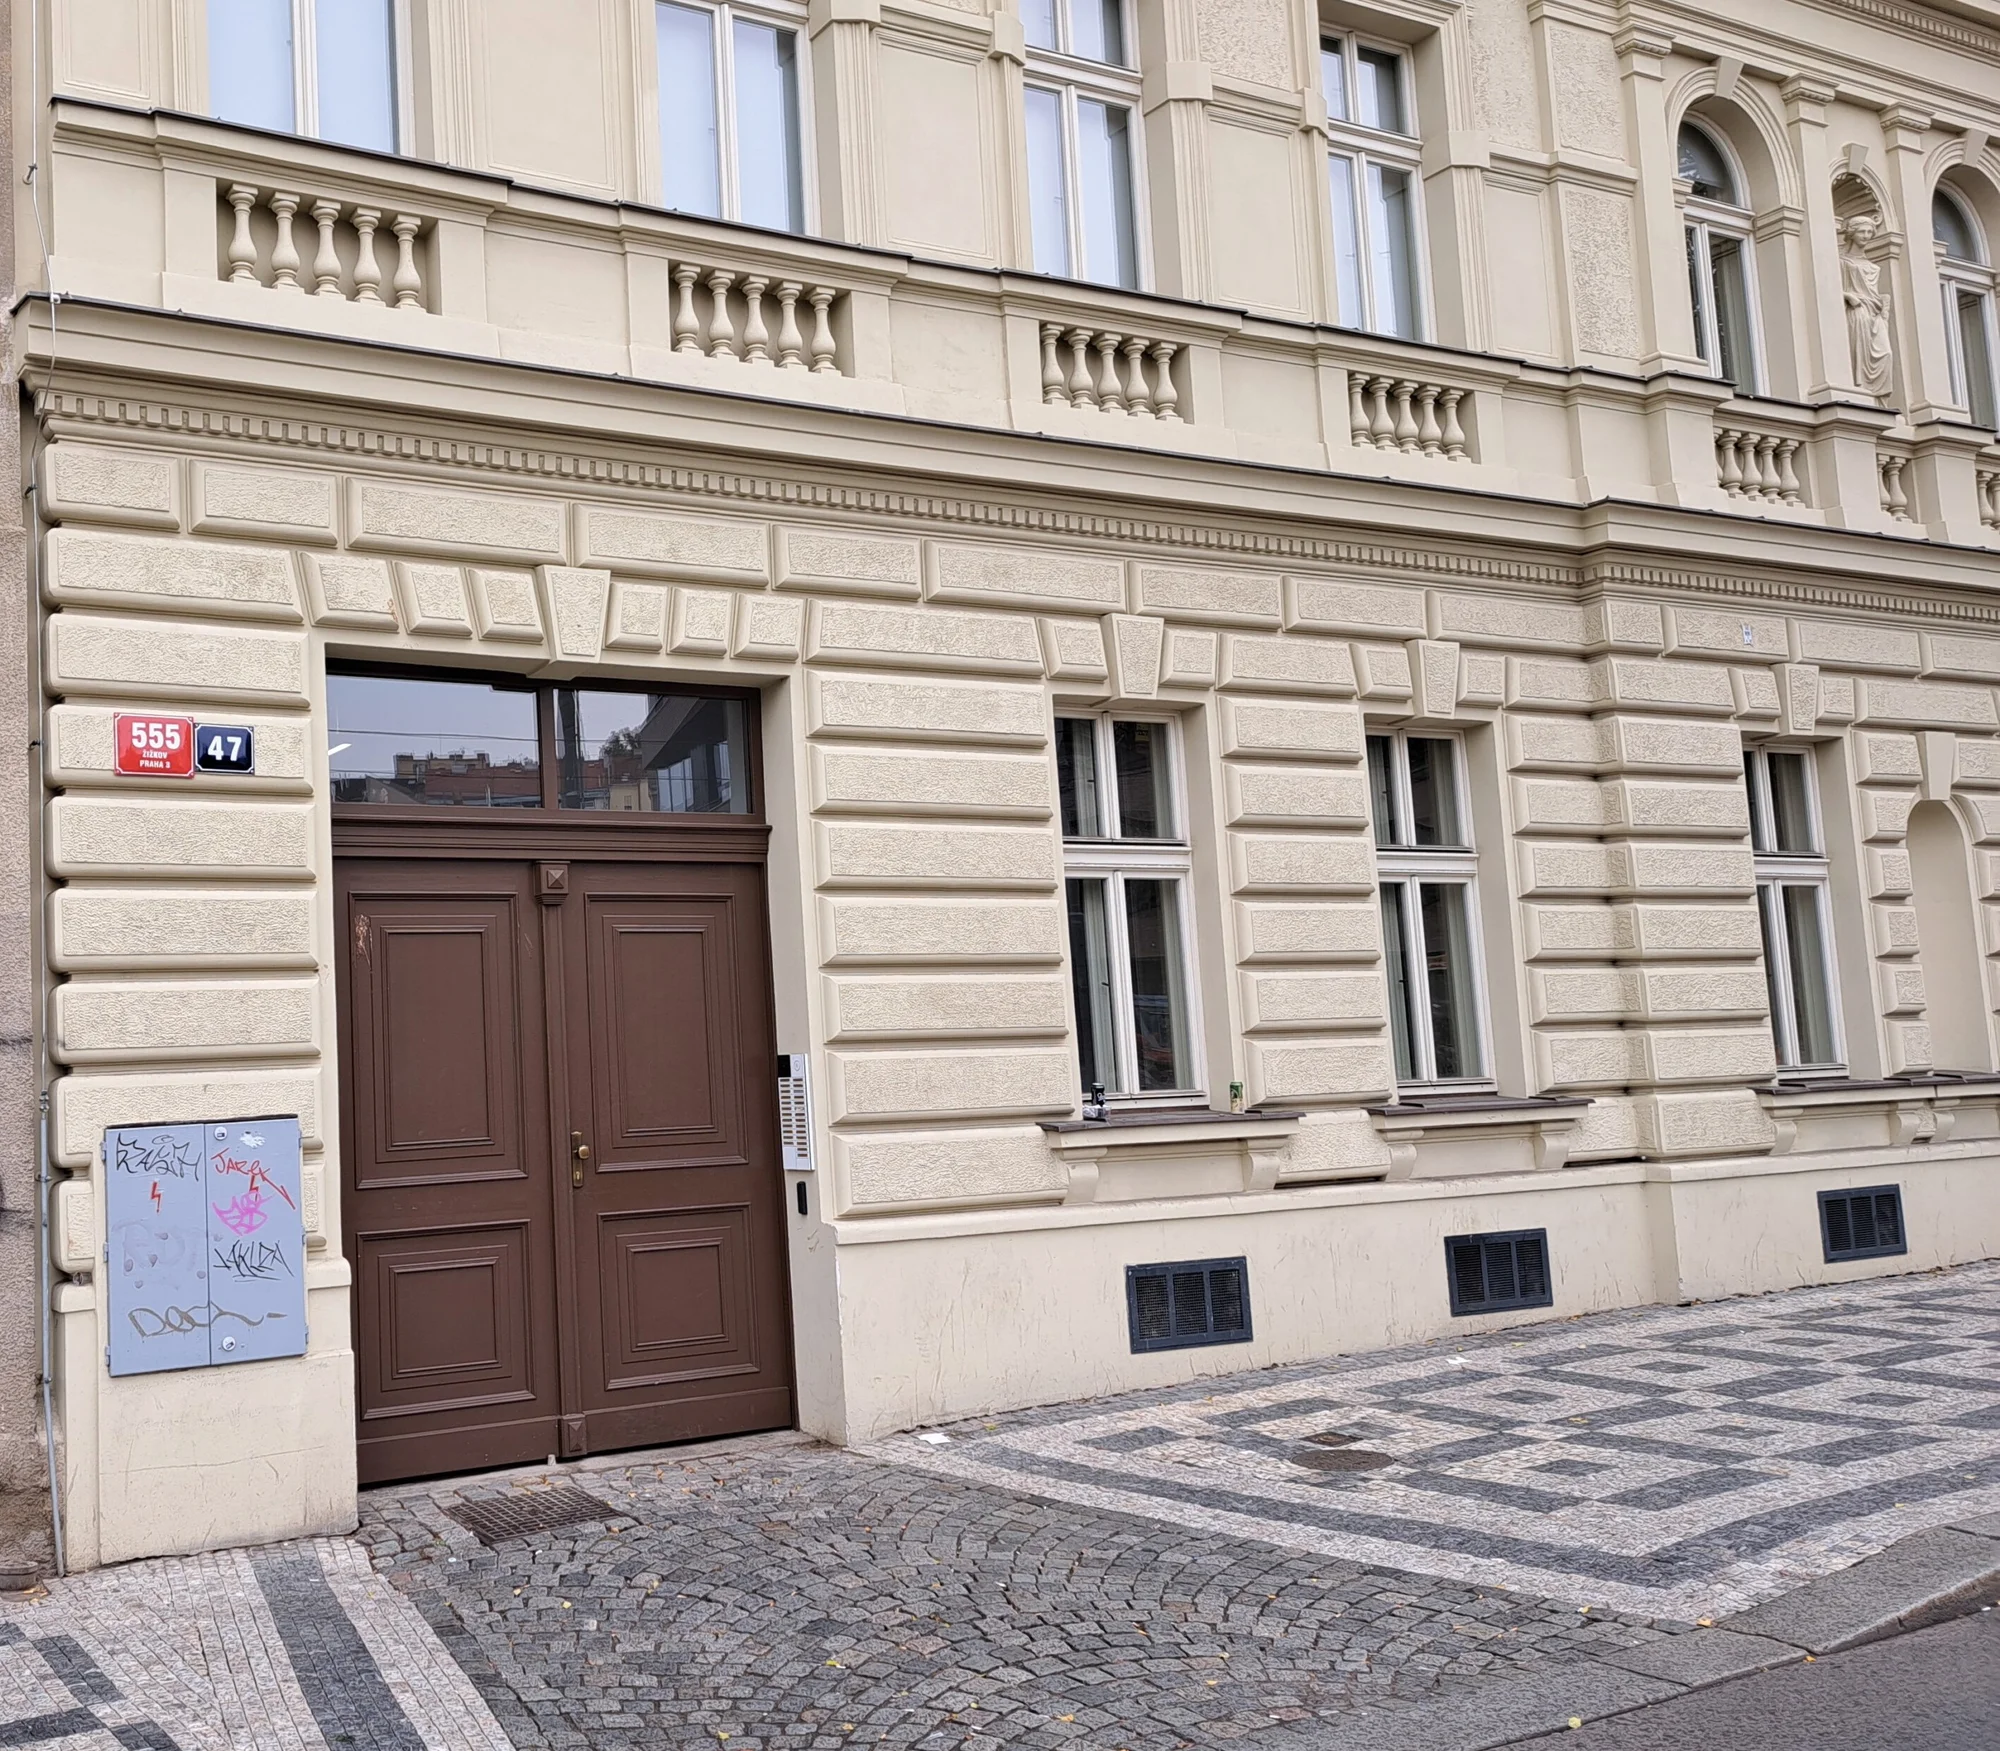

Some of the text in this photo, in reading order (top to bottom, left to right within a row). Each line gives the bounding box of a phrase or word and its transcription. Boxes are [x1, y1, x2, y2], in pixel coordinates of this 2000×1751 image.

[132, 722, 181, 749] 555
[208, 736, 242, 761] 47
[139, 759, 171, 769] PRAHA 3
